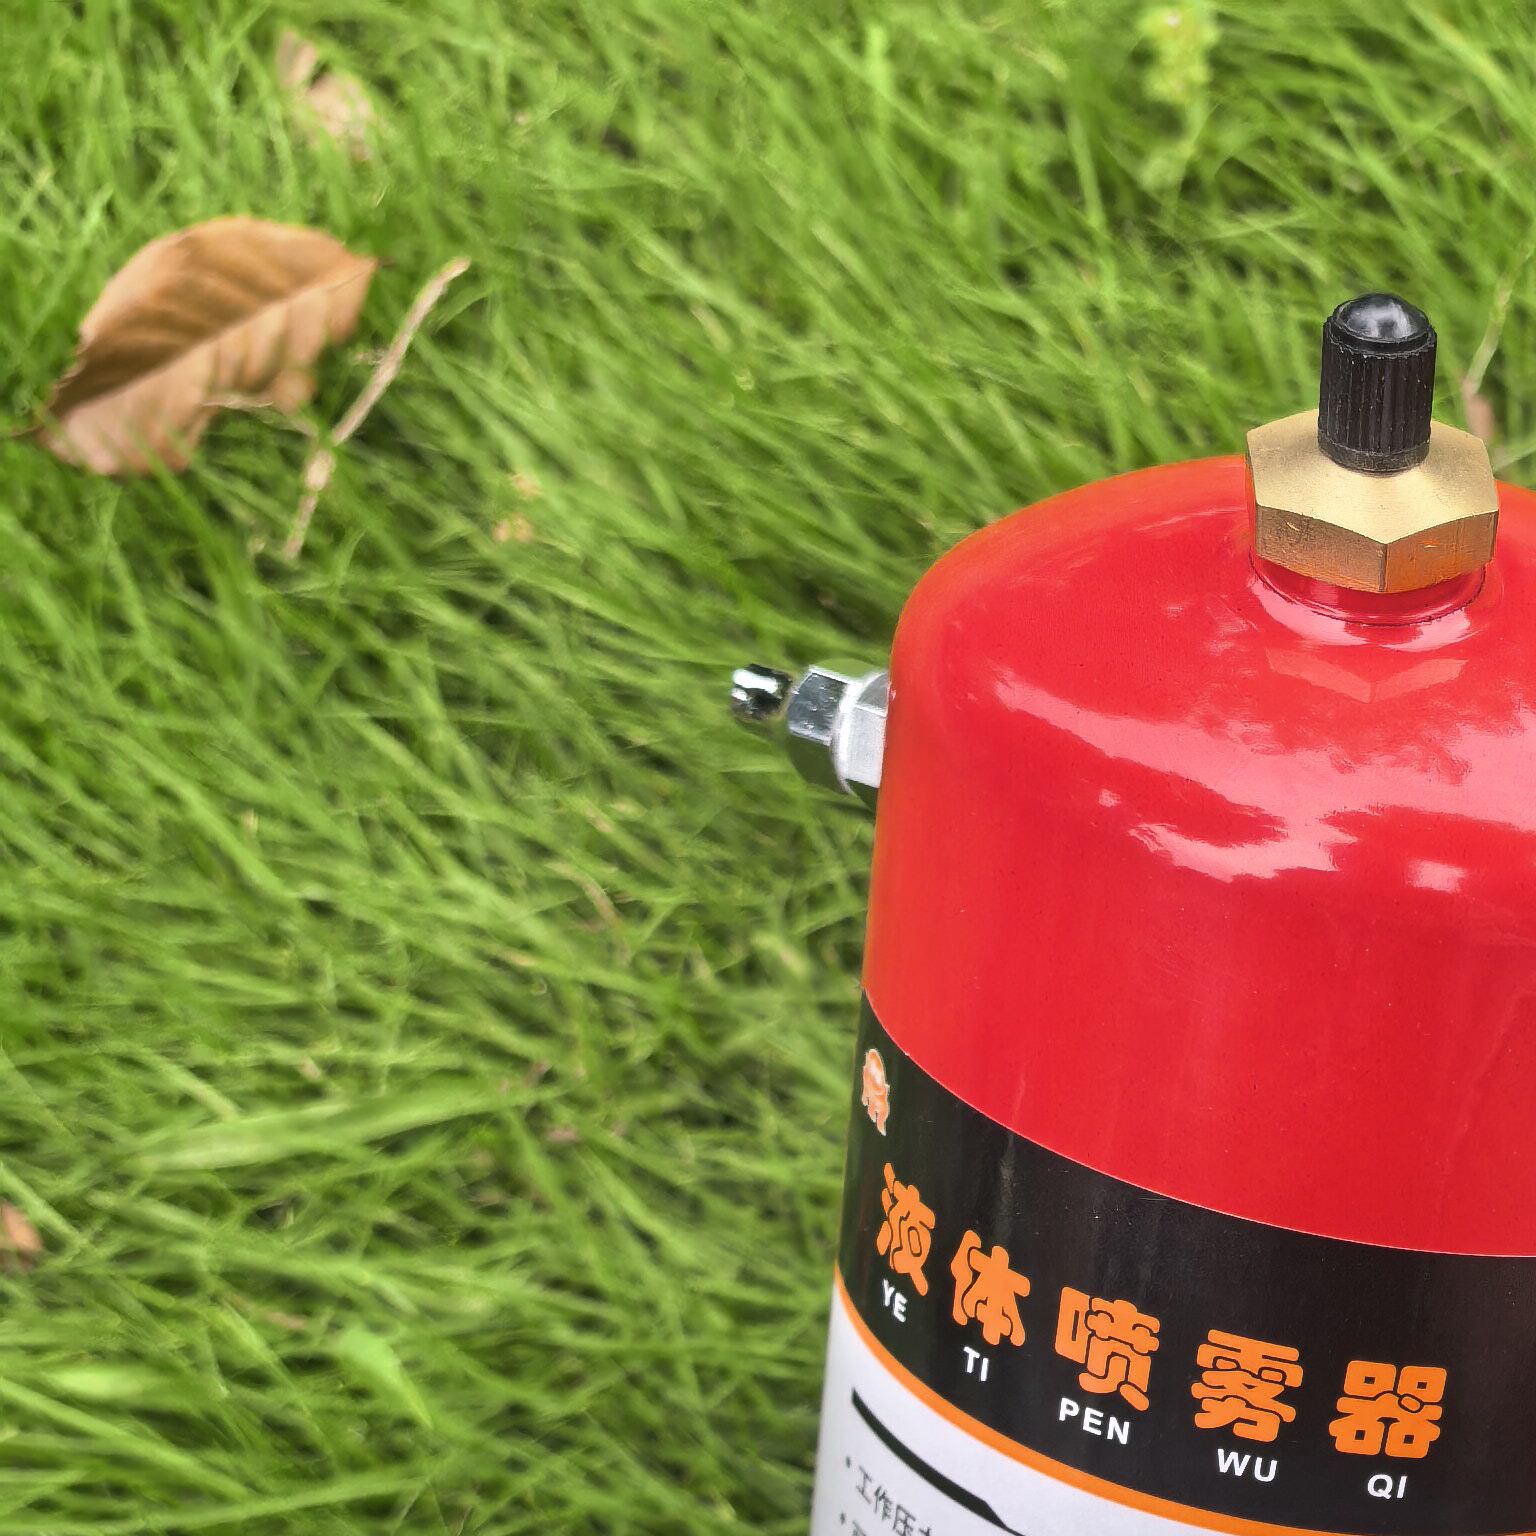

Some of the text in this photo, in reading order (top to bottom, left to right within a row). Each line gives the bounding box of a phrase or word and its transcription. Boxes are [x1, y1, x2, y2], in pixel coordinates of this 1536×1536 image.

[877, 1162, 1447, 1458] 液体喷雾器
[881, 1280, 1407, 1499] YE TI PEN WU QI
